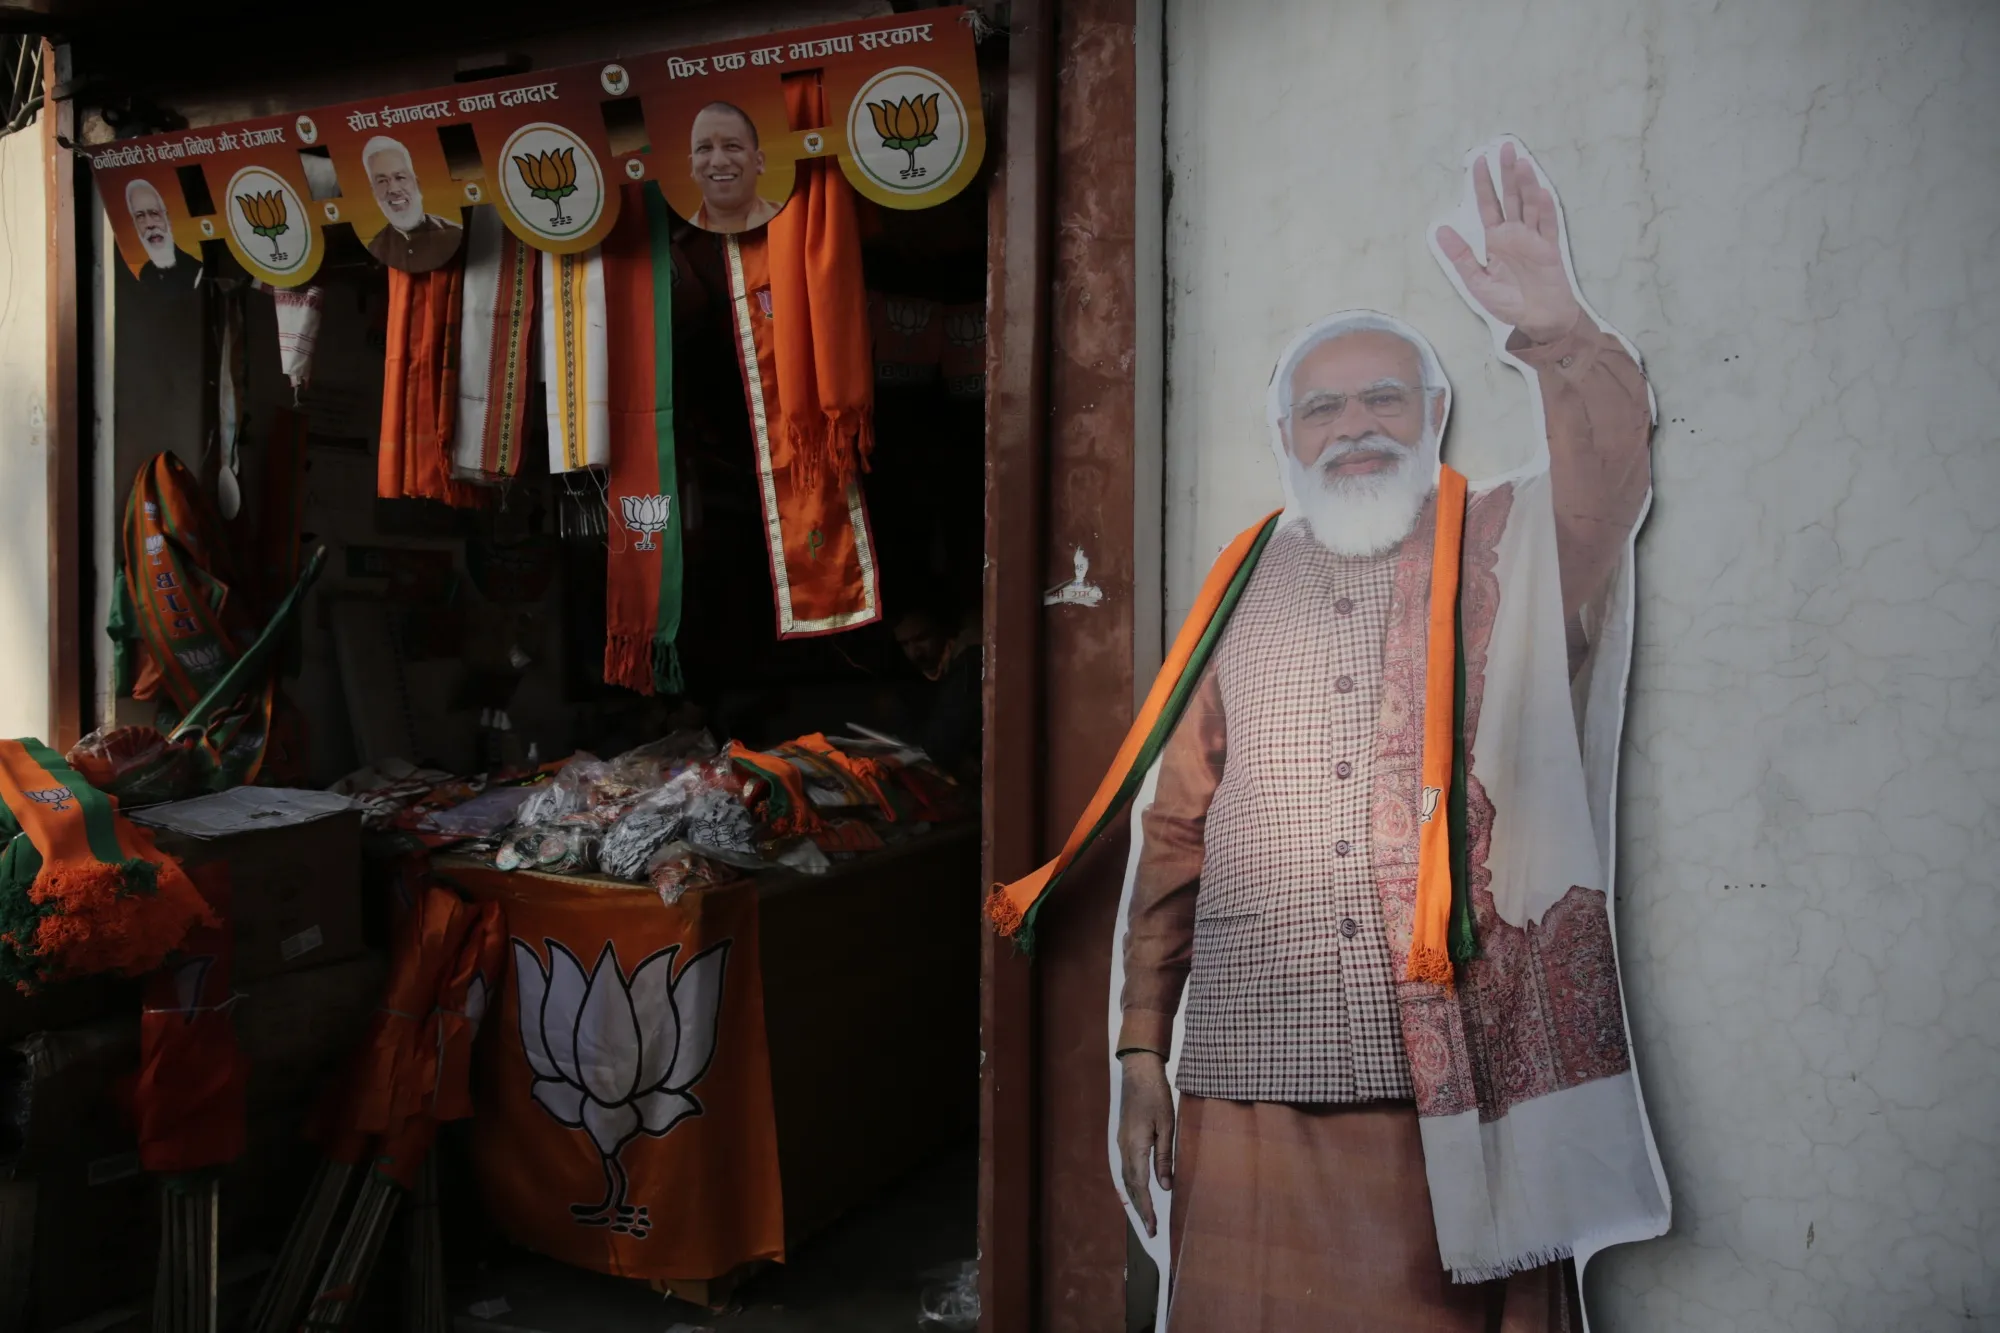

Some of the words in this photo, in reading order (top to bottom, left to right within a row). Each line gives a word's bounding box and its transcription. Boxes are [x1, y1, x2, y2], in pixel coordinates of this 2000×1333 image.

[667, 55, 708, 80] फिर
[712, 51, 746, 70] एक
[751, 45, 785, 64] बार
[788, 34, 854, 60] भाजपा
[858, 23, 934, 51] सरकार
[347, 110, 378, 132] सोच
[457, 92, 496, 114] काम
[498, 82, 559, 107] दमदार
[145, 143, 156, 163] से
[183, 136, 215, 155] निवेश
[217, 131, 239, 151] और
[240, 127, 286, 148] रोजगार
